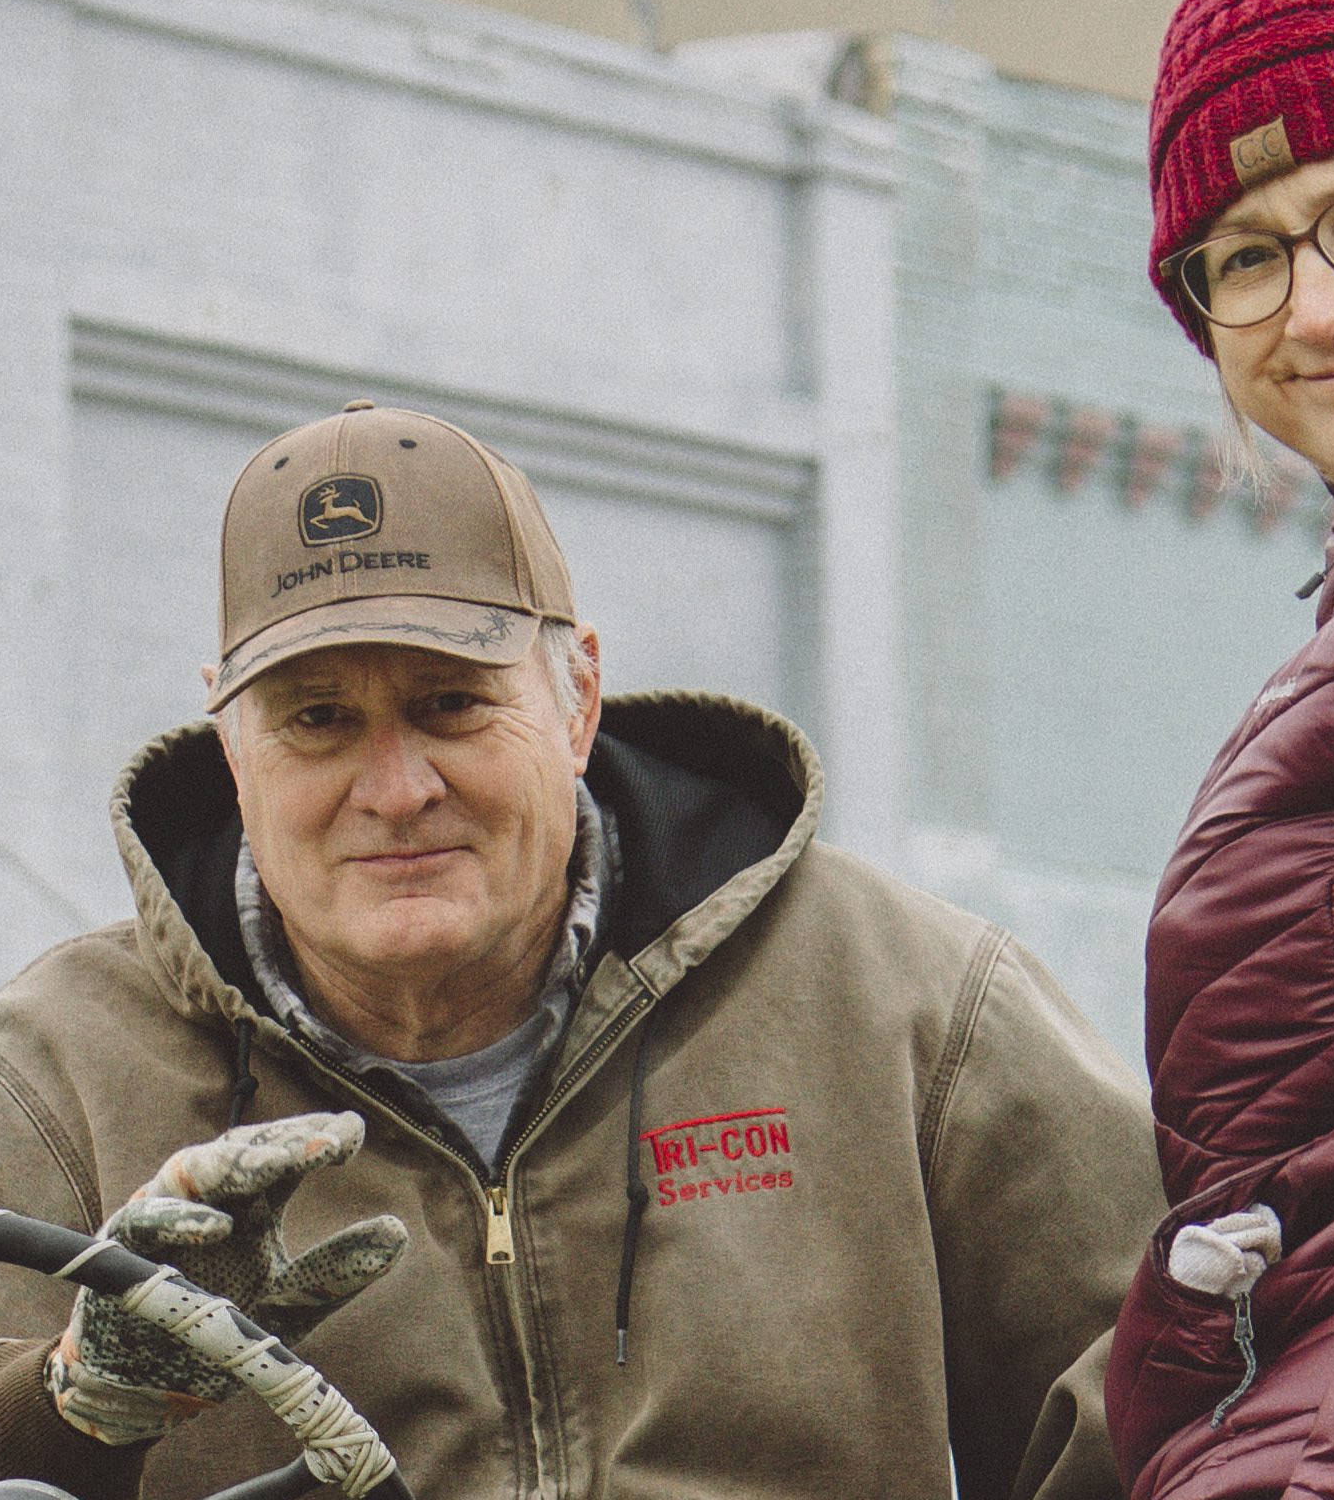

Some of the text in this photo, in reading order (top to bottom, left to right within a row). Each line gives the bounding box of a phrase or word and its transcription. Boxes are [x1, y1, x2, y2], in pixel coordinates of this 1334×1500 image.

[271, 551, 431, 598] JOHN DEERE
[639, 1108, 790, 1175] TRI-CON
[657, 1170, 793, 1206] Services
